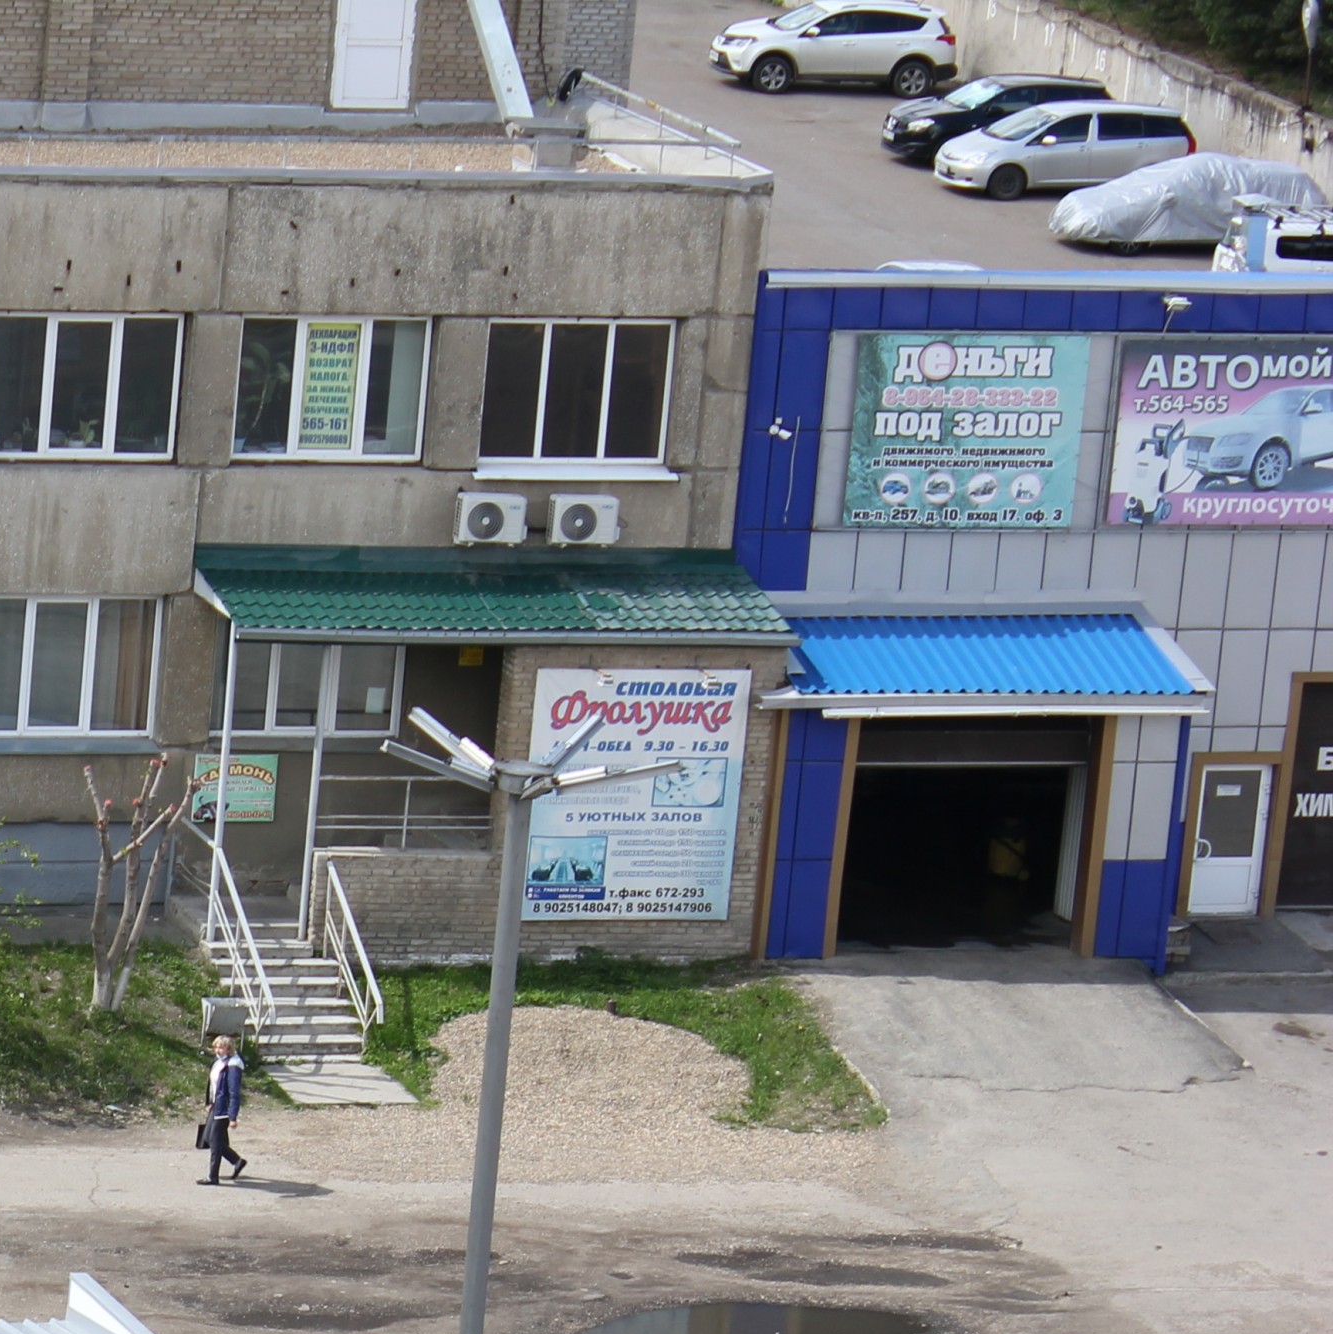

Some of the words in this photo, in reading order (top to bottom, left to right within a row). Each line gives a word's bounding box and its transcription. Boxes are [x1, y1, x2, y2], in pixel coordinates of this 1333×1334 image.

[309, 358, 353, 367] ВОЗВРАТ
[1134, 395, 1229, 412] т.564-565
[304, 406, 349, 414] ОБУЧЕНИЕ
[302, 418, 347, 430] 565-161
[873, 412, 942, 441] под
[953, 412, 1061, 437] залог
[962, 447, 1045, 457] недвижимого
[884, 458, 979, 469] коммерческого
[984, 459, 1053, 468] имущества
[967, 510, 998, 521] вход
[644, 741, 674, 751] 9.30
[692, 741, 729, 751] 16.30
[201, 765, 274, 785] ГАМОНЬ
[578, 813, 645, 822] УЮТНЫХ
[651, 813, 702, 822] ЗАЛОВ
[609, 888, 653, 899] т.факс
[656, 888, 705, 898] 672-293
[544, 903, 622, 915] 9025148047;
[637, 903, 711, 913] 9025147906
